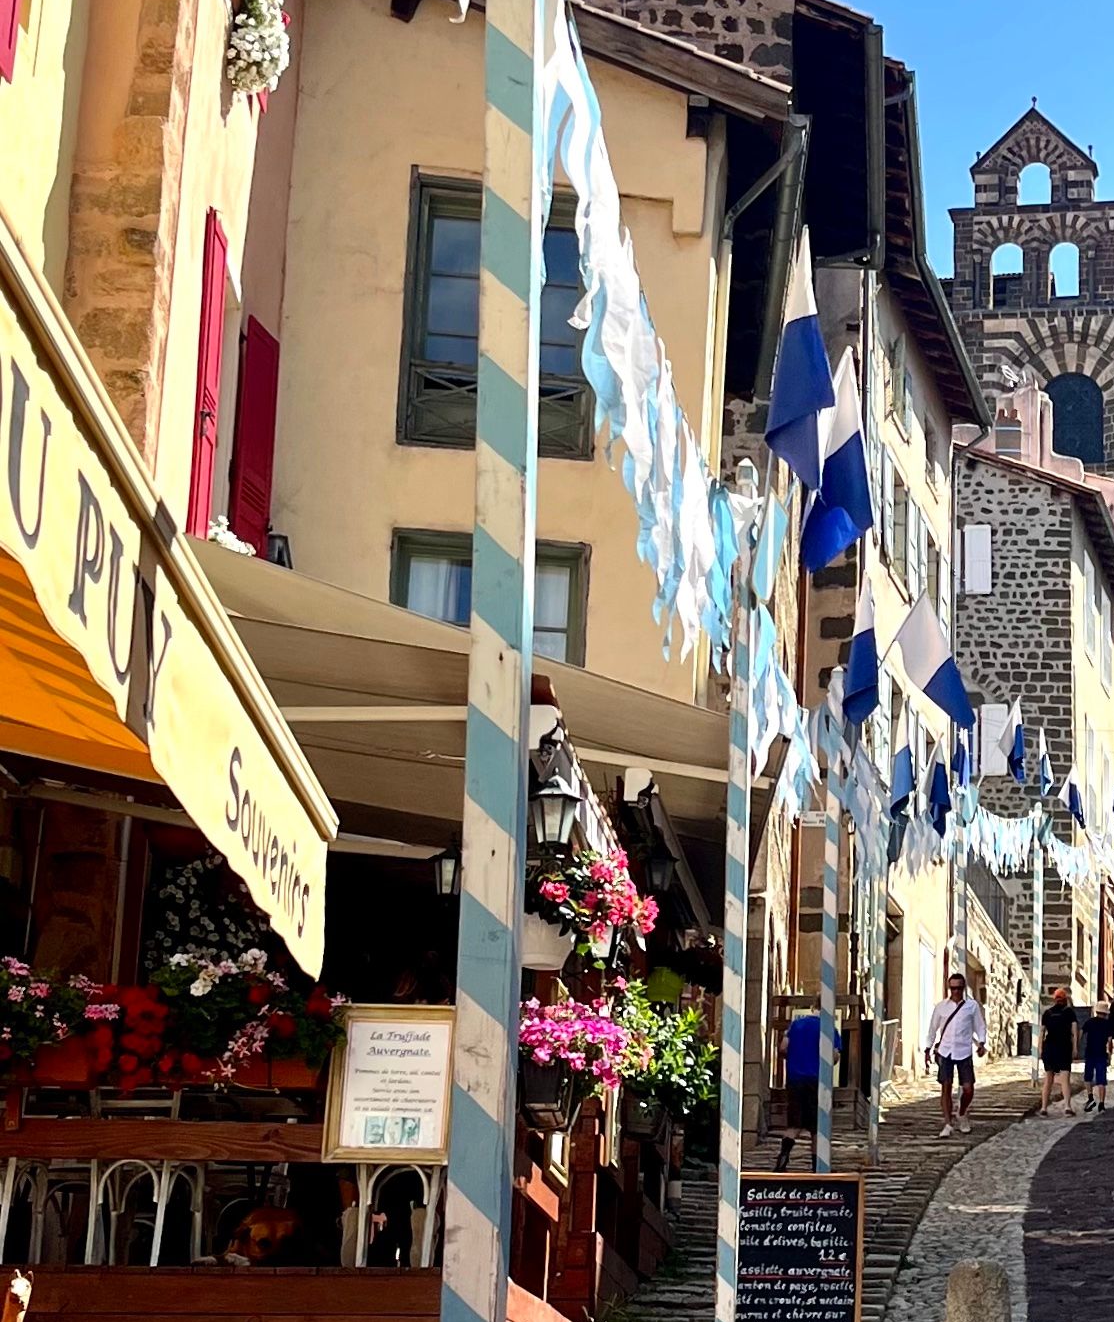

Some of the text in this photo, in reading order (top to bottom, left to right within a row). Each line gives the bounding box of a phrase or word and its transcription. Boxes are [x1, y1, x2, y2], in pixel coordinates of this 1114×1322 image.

[0, 351, 172, 731] U PUY
[225, 746, 310, 939] Souvenirs
[370, 1030, 432, 1043] La Truffade
[366, 1046, 432, 1058] Auvergnate.
[747, 1187, 787, 1200] Salade
[789, 1187, 802, 1200] de
[739, 1205, 854, 1220] fusilli, truite fumée,
[739, 1220, 837, 1235] tomates confites,
[739, 1235, 760, 1246] uile
[763, 1234, 808, 1249] d'olives,
[738, 1262, 784, 1275] 'assiette
[737, 1280, 771, 1290] ambon
[774, 1279, 786, 1290] de
[789, 1282, 818, 1294] pays,
[736, 1293, 752, 1305] âté
[754, 1297, 767, 1305] en
[771, 1308, 782, 1319] et
[786, 1308, 822, 1319] chèvre
[824, 1311, 847, 1320] sur
